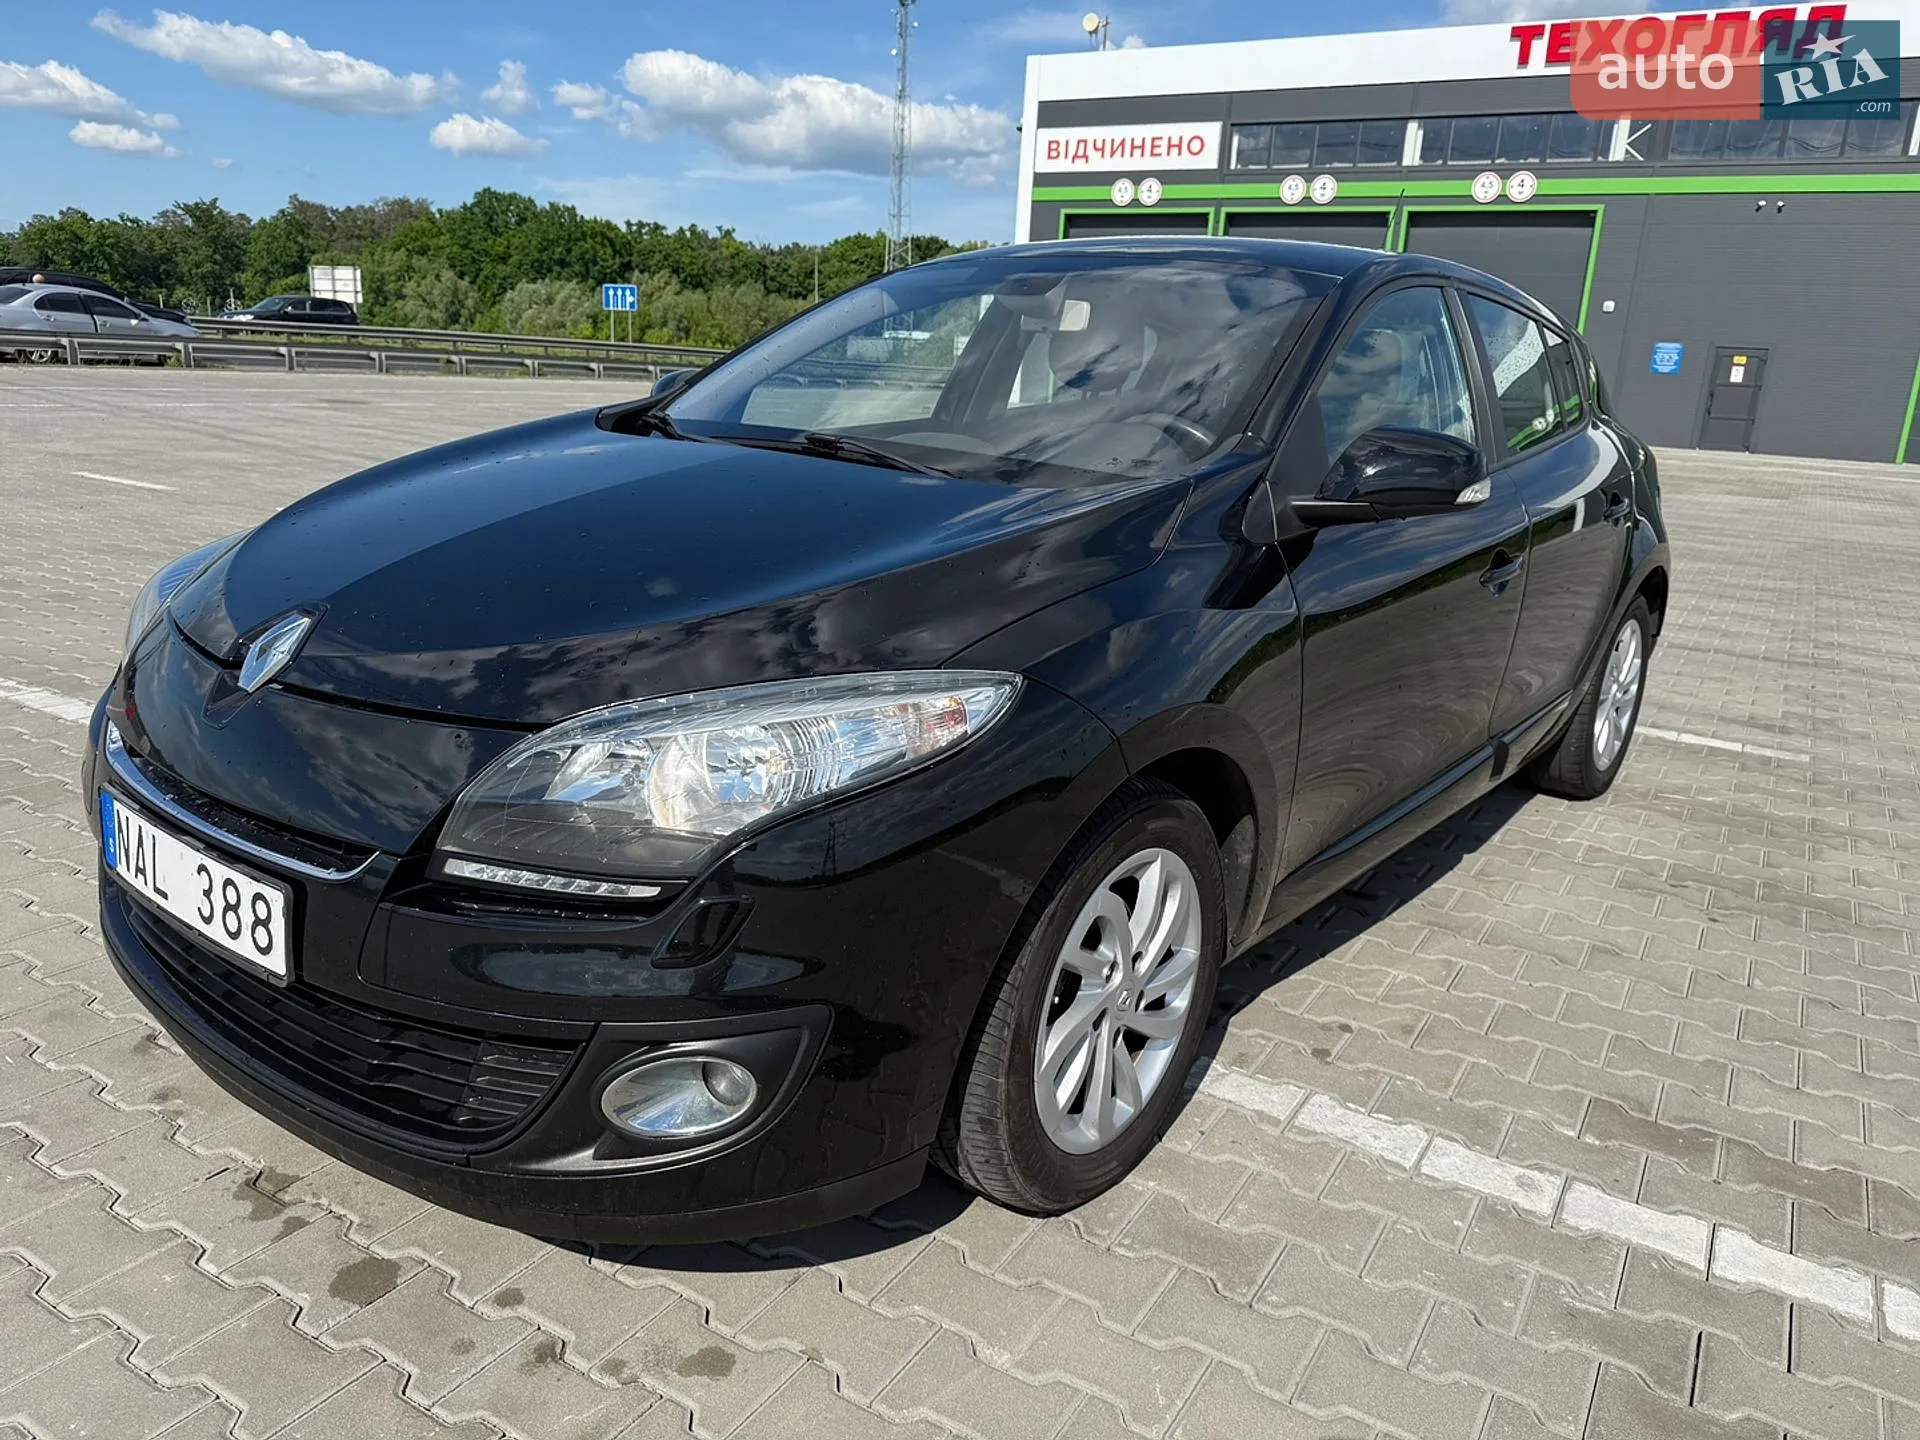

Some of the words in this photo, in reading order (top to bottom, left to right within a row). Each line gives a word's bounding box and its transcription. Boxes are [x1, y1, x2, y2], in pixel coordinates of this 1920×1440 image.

[1510, 4, 1848, 69] ТЕХОГЛЯД
[1047, 135, 1205, 164] ВІДЧИНЕНО
[116, 809, 169, 901] NAL
[197, 863, 274, 956] 388
